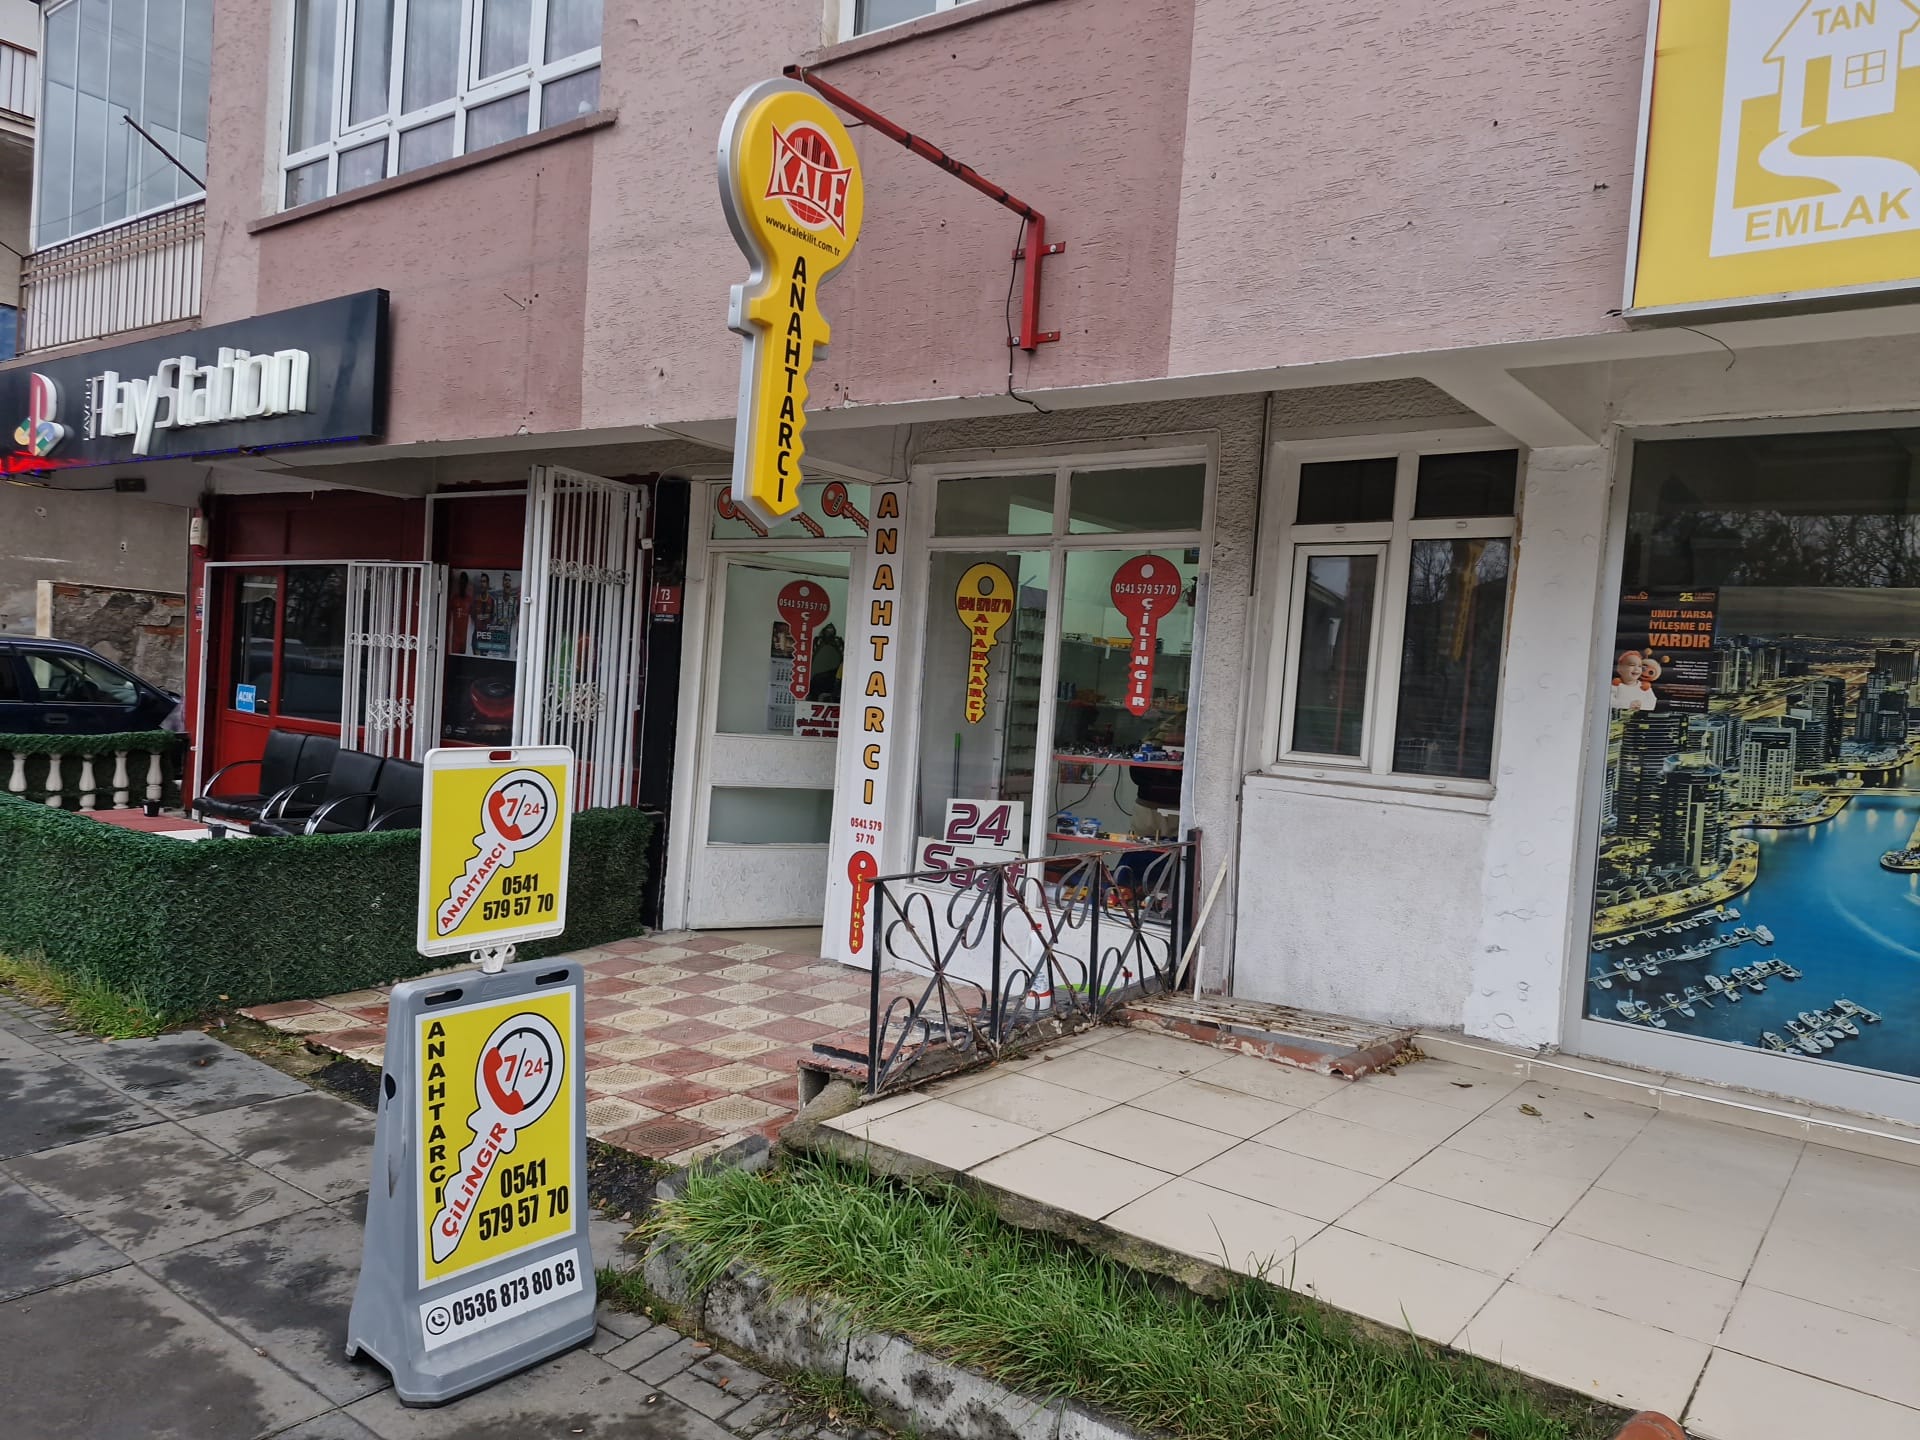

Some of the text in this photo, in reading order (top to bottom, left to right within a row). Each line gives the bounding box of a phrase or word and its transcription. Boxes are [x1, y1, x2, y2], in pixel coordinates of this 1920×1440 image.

[1812, 0, 1876, 35] TAN
[770, 140, 848, 223] KALE
[1745, 187, 1913, 242] EMLAK
[765, 215, 841, 257] www.kalekilit.com.tr
[776, 255, 808, 502] ANAHTARCI
[90, 346, 311, 456] PlayStation
[661, 588, 671, 601] 73
[1115, 583, 1177, 595] 0541 579 57 70
[1680, 592, 1694, 602] 25
[1651, 610, 1713, 619] UMUT VARSA
[1698, 622, 1713, 631] DE
[476, 631, 492, 640] PES
[862, 491, 900, 804] ANAHTARCI
[1648, 632, 1711, 648] VARDIR
[968, 613, 990, 722] ANAHTARCI
[505, 794, 541, 824] 7/24
[851, 817, 882, 831] 0541 579
[946, 802, 1012, 847] 24
[856, 832, 875, 845] 57 70
[440, 842, 507, 928] ANAHTARCI
[502, 873, 539, 896] 0541
[483, 893, 554, 921] 579 57 70
[503, 1047, 545, 1091] 7/24
[427, 1021, 447, 1204] ANAHTARCI
[500, 1158, 547, 1198] 0541
[478, 1185, 570, 1241] 579 57 70
[452, 1259, 576, 1326] 0536 873 80 83
